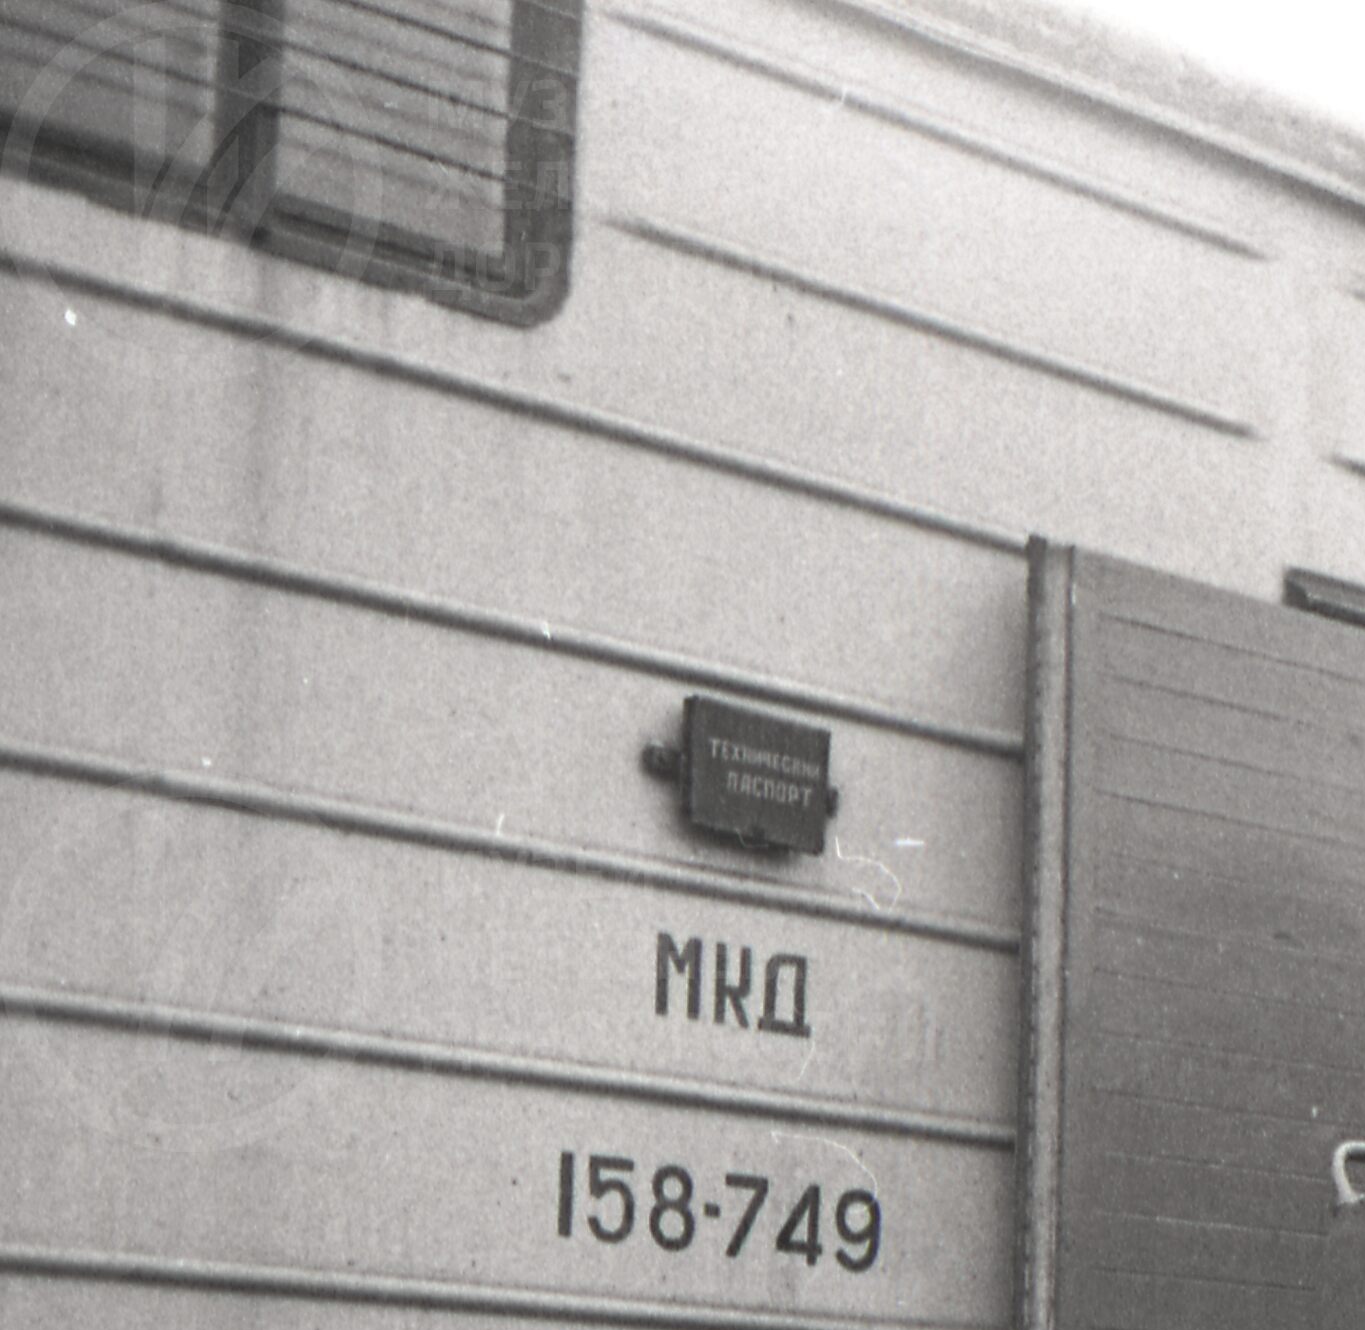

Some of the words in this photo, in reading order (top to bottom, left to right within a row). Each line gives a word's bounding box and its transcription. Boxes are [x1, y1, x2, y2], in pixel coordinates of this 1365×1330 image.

[726, 770, 814, 808] ПАСПОРТ
[654, 930, 811, 1038] МКД
[557, 1151, 882, 1273] 158-749
